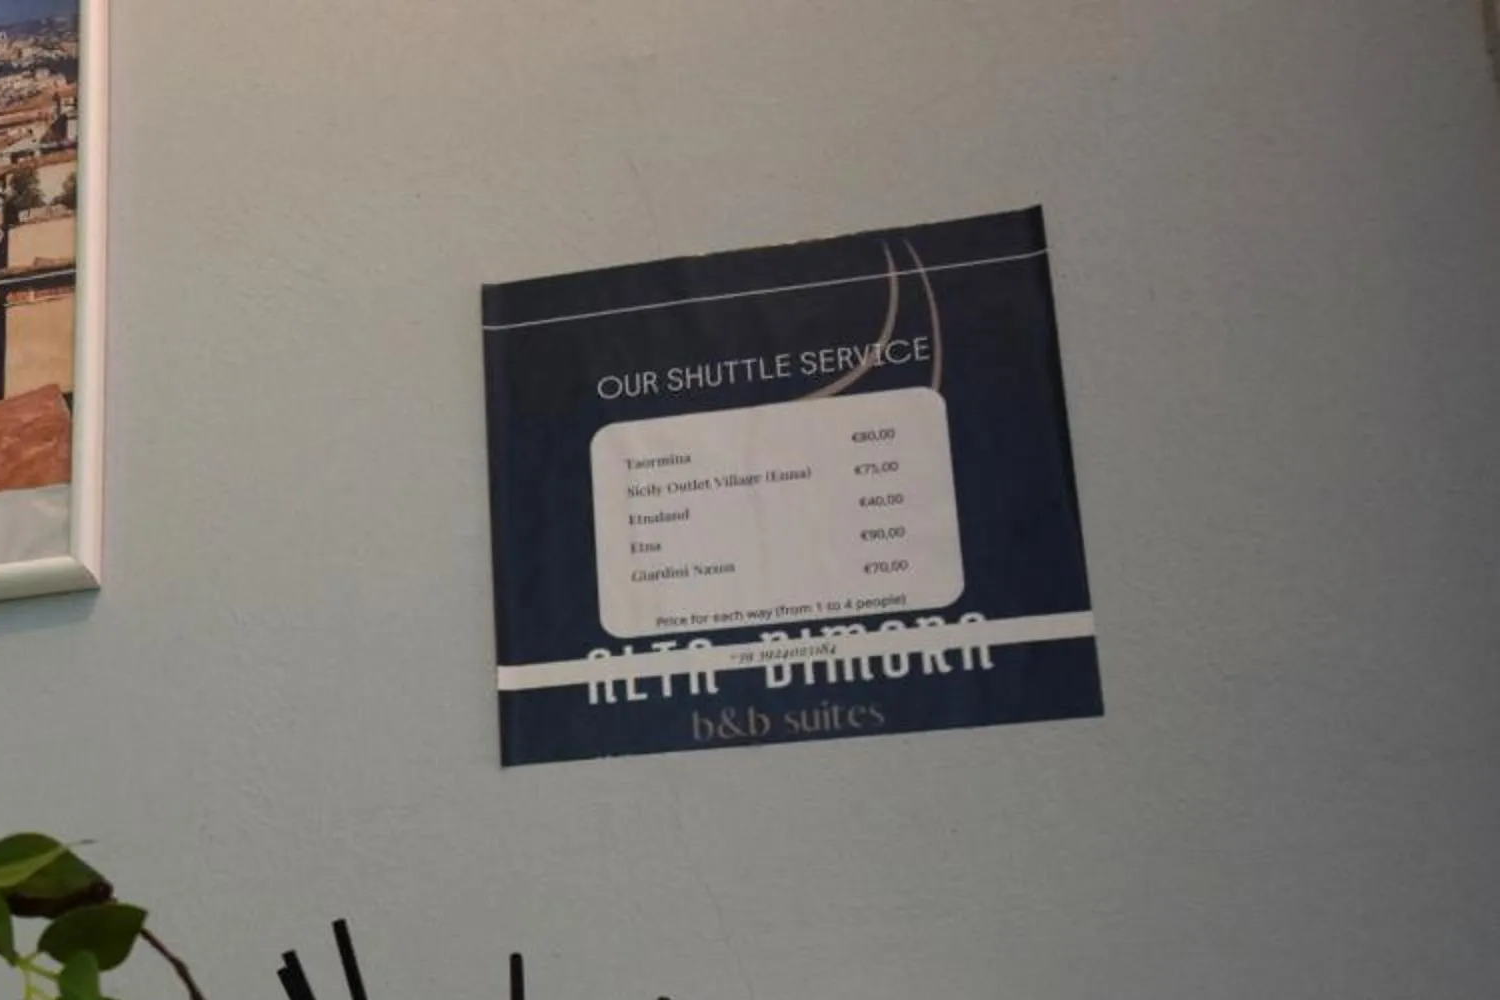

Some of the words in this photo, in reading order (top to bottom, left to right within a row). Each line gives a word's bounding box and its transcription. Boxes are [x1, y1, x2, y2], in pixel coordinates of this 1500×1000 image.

[597, 370, 659, 400] OUR
[667, 353, 793, 392] SHUTTLE
[799, 336, 932, 376] SERVICE
[625, 452, 692, 471] Taormina
[626, 482, 663, 499] Sicily
[666, 478, 711, 495] Outlet
[713, 471, 762, 488] Village
[765, 466, 813, 484] (Enna)
[628, 508, 690, 527] Etnaland
[630, 541, 663, 555] Etna
[631, 565, 690, 584] Giardini
[691, 612, 709, 625] for
[712, 609, 744, 623] each
[747, 609, 772, 622] way
[692, 706, 771, 742] b&b
[784, 699, 886, 733] suites
